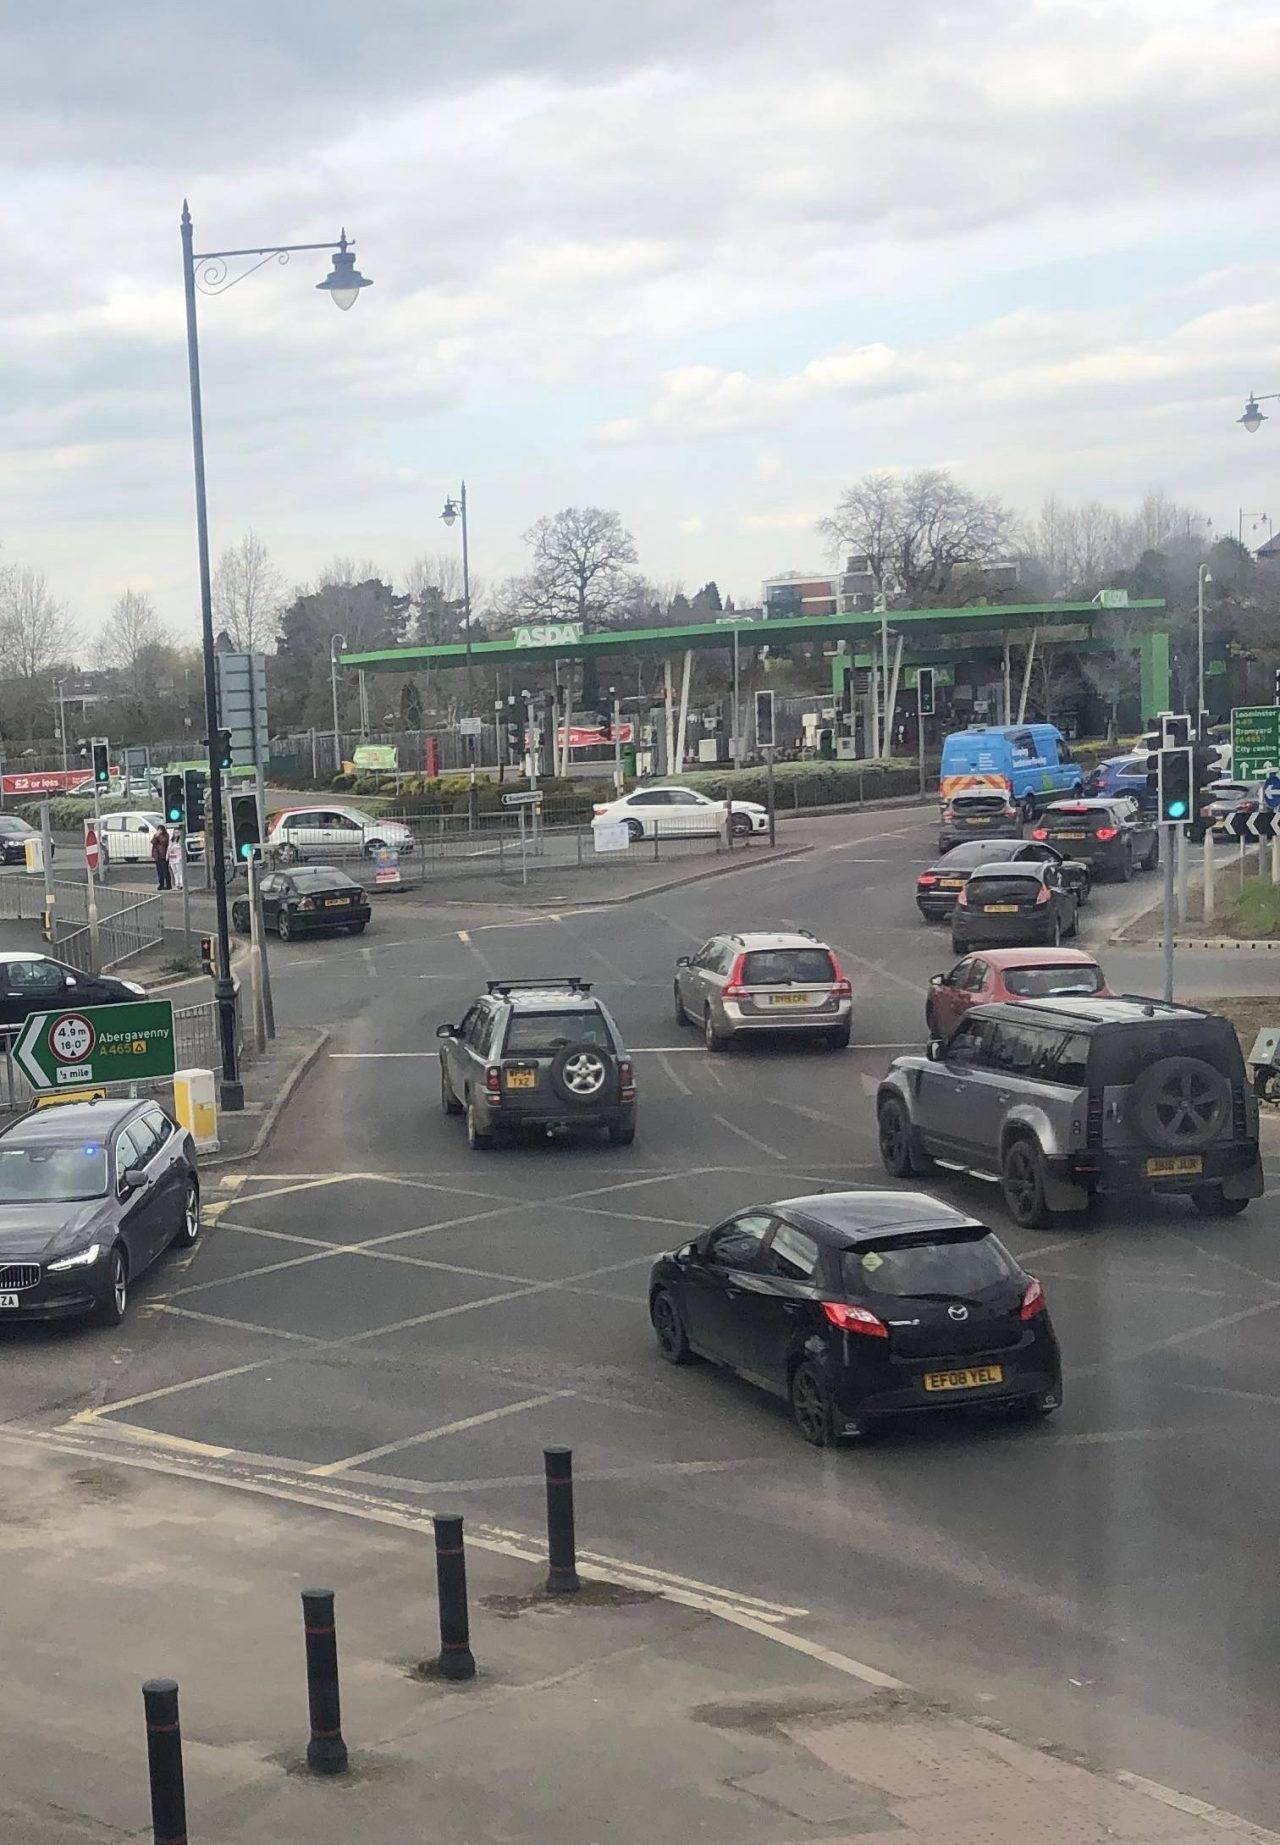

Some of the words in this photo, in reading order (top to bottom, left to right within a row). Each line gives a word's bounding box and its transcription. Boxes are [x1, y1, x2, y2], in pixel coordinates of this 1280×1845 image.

[516, 625, 577, 648] ASDA
[911, 670, 951, 683] ADA
[1235, 710, 1277, 718] Leominster
[1235, 727, 1273, 735] Bromyard
[1253, 744, 1277, 752] centre
[14, 778, 29, 789] £2
[31, 780, 40, 788] or
[41, 779, 59, 787] less
[58, 1027, 76, 1037] 4.9
[98, 1028, 169, 1044] Abergavenny
[100, 1043, 132, 1056] A465
[69, 1068, 89, 1078] mile
[931, 1371, 967, 1388] EF08
[969, 1368, 996, 1383] YEL
